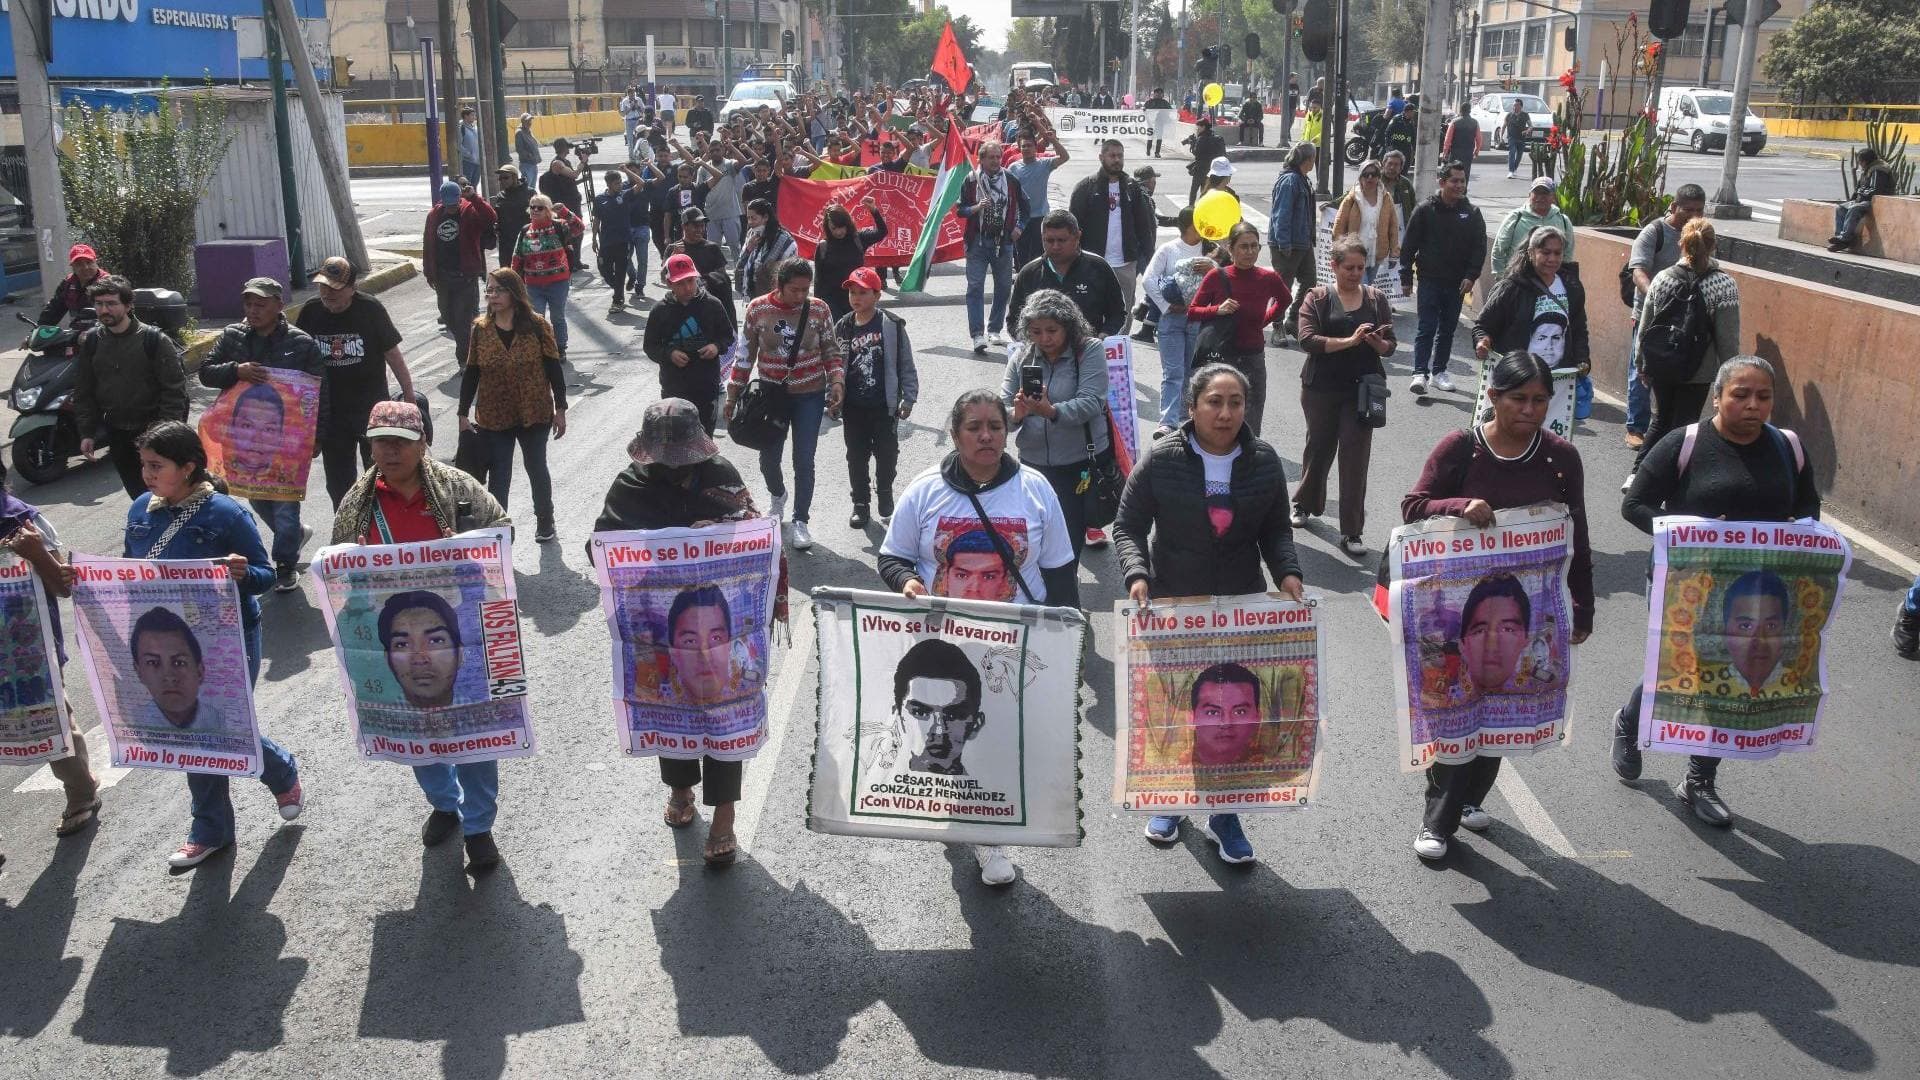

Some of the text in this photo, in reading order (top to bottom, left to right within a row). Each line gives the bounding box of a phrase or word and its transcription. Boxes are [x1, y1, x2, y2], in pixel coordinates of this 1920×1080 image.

[152, 8, 228, 30] ESPECIALISTAS
[1092, 114, 1146, 123] PRIMERO
[1085, 126, 1154, 136] LOS FOLIOS
[1404, 523, 1565, 562] ¡Vivo se lo llevaron!
[1671, 526, 1842, 550] ¡Vivo se lo llevaron!
[324, 542, 498, 574] ¡Vivo se lo llevaron!
[609, 533, 772, 568] ¡Vivo se lo llevaron!
[118, 568, 136, 580] se
[140, 566, 156, 580] lo
[159, 564, 230, 580] llevaron!
[483, 600, 516, 630] NOS
[1131, 608, 1312, 636] ¡Vivo se lo llevaron!
[354, 626, 373, 641] 43
[862, 614, 901, 634] ¡Vivo
[905, 621, 921, 634] se
[944, 618, 1018, 644] llevaron!
[486, 632, 524, 680] FALTAN
[364, 680, 383, 694] 43
[640, 710, 682, 721] ANTONIO
[372, 730, 516, 754] ¡Vivo lo queremos!
[640, 732, 678, 748] ¡Vivo
[682, 736, 698, 749] lo
[1660, 724, 1706, 742] ¡Vivo
[1712, 728, 1728, 744] lo
[1465, 738, 1476, 752] lo
[125, 746, 249, 772] ¡Vivo lo queremos!
[870, 782, 1006, 802] GONZÁLEZ HERNÁNDEZ
[894, 774, 982, 790] CÉSAR MANUEL
[860, 794, 1014, 818] ¡Con VIDA lo queremos!
[1136, 788, 1297, 809] ¡Vivo lo queremos!
